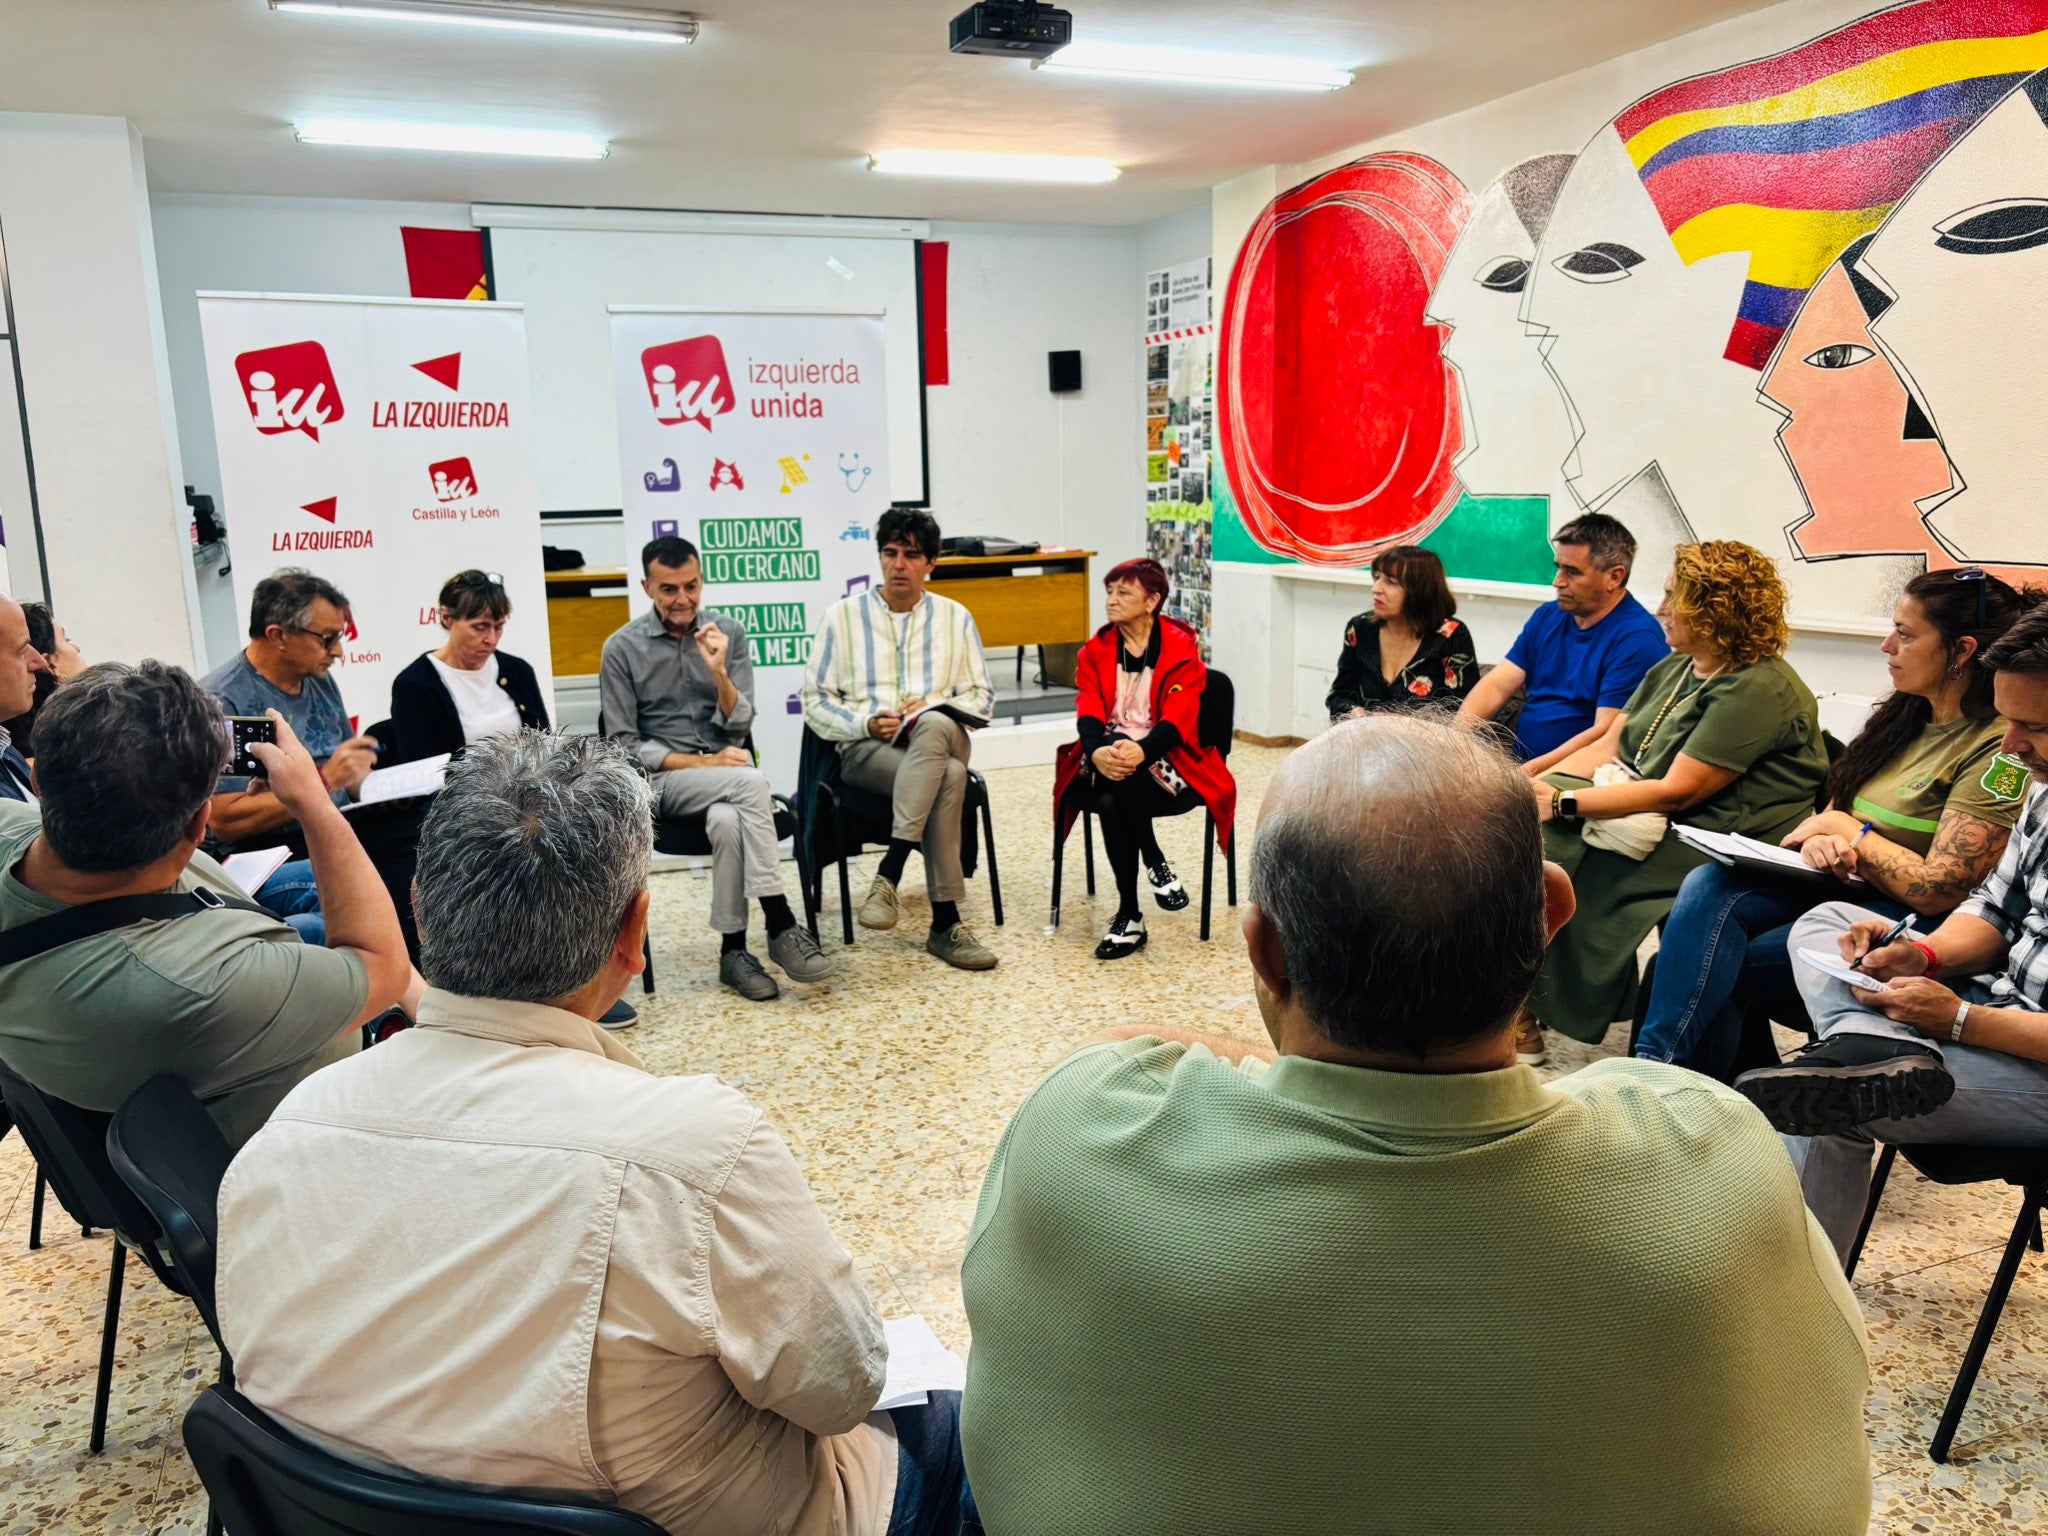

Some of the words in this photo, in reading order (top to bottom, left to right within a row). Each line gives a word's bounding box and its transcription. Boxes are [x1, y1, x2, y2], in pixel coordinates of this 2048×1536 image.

[748, 357, 861, 390] izquierda
[249, 370, 332, 429] iu
[652, 364, 726, 419] iu
[751, 392, 823, 418] unida
[372, 401, 398, 428] LA
[403, 401, 509, 428] IZQUIERDA
[412, 507, 457, 521] Castilla
[459, 510, 467, 522] y
[471, 506, 500, 520] León
[272, 530, 292, 552] LA
[295, 529, 374, 551] IZQUIERDA
[703, 519, 800, 549] CUIDAMOS
[706, 557, 730, 582] LO
[734, 552, 818, 581] CERCANO
[709, 606, 760, 633] RA
[763, 604, 804, 632] UNA
[350, 650, 381, 664] León
[765, 635, 813, 665] MEJO
